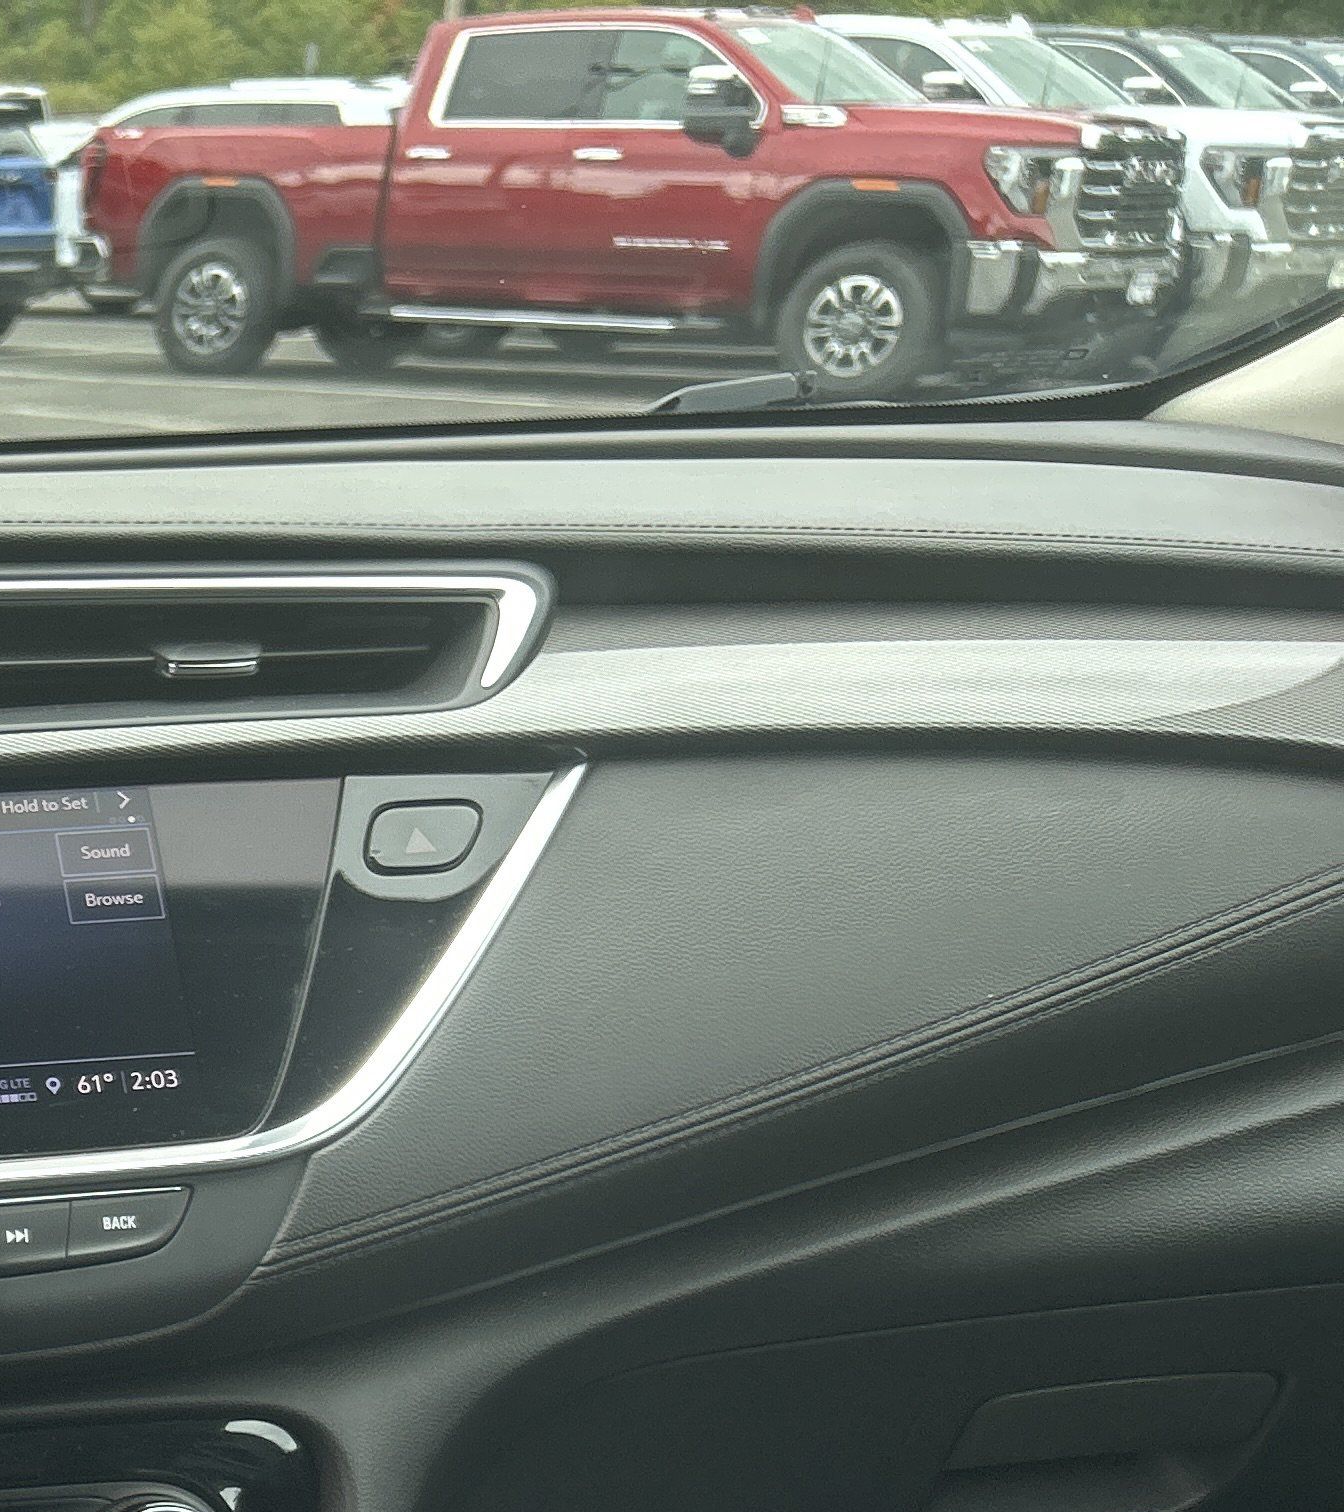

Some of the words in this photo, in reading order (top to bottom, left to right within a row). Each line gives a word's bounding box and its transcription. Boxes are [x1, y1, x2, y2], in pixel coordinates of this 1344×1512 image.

[1, 799, 39, 815] Hold
[41, 800, 59, 812] to
[62, 797, 89, 811] Set
[80, 843, 131, 860] Sound
[85, 892, 144, 907] Browse
[10, 1078, 31, 1090] LTE
[77, 1072, 114, 1094] 61°
[130, 1069, 179, 1091] 2:03
[102, 1215, 137, 1231] BACK
